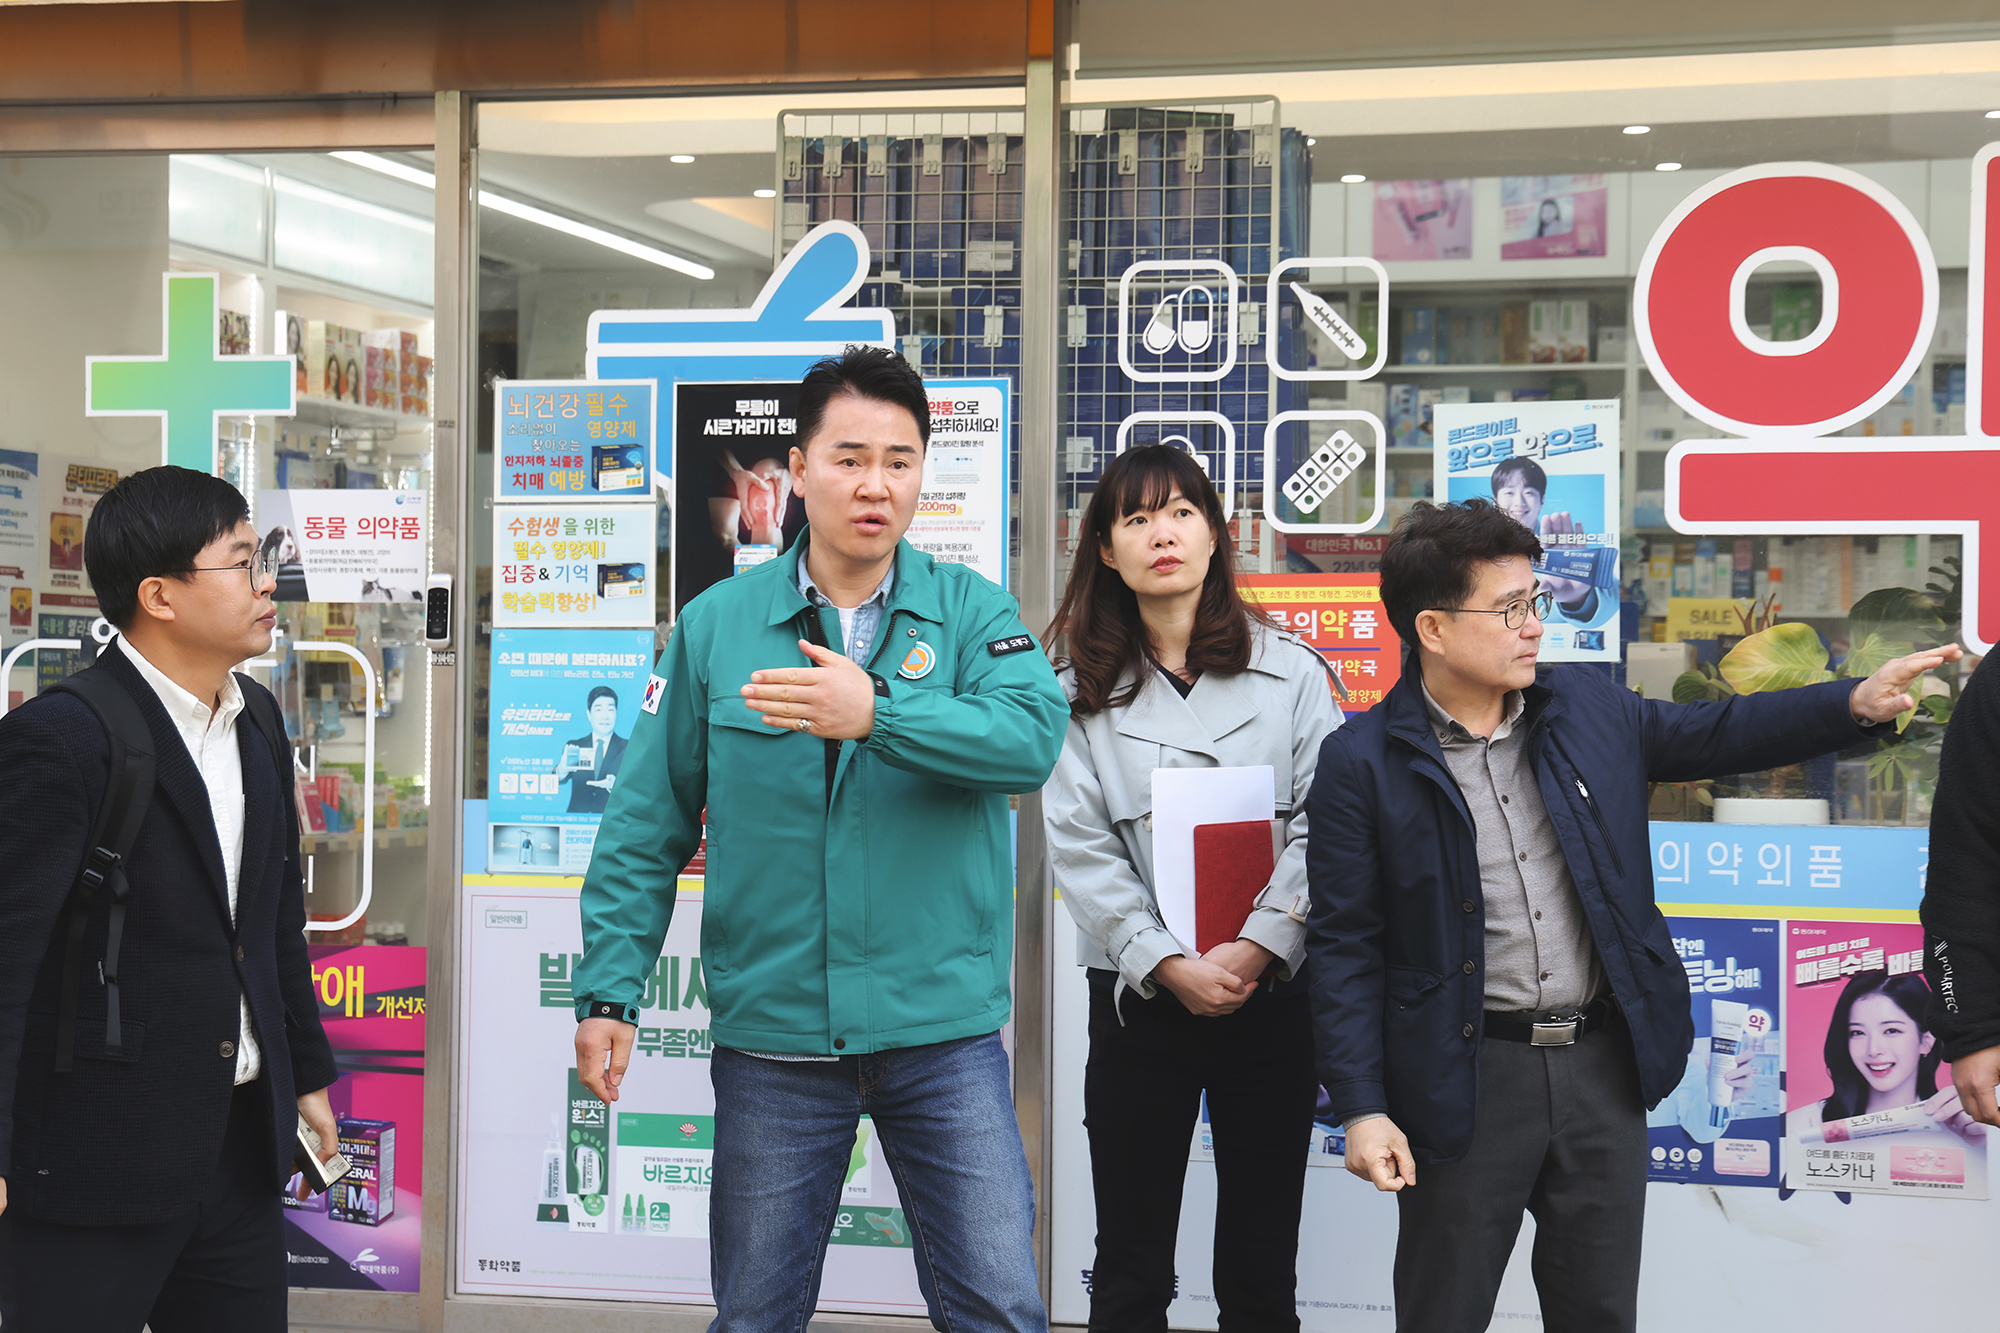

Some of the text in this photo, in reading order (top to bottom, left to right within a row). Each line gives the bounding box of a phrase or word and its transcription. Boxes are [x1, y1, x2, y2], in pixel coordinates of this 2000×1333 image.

[507, 392, 629, 419] 뇌건강 필수
[735, 399, 780, 417] 무릎이
[507, 422, 557, 436] 소리없이
[587, 420, 636, 438] 영양제
[703, 418, 775, 435] 시큰거리기
[930, 418, 999, 433] 섭취하세요!
[531, 439, 582, 453] 찾아오는
[504, 455, 585, 468] 인지저하 뇌졸중
[512, 469, 586, 491] 치매 예방
[930, 492, 945, 501] 권장
[945, 492, 967, 501] 섭취량
[304, 516, 421, 540] 동물 의약품
[583, 517, 616, 536] 위한
[513, 540, 606, 560] 필수 영양제!
[922, 543, 943, 552] 용량을
[944, 543, 973, 552] 복용해야
[1305, 538, 1382, 553] 대한민국 No.1
[554, 564, 588, 583] 기억
[1294, 590, 1317, 599] 중형견,
[1319, 590, 1342, 599] 대형견,
[1344, 590, 1373, 599] 고양이용
[1690, 609, 1733, 625] SALE
[497, 652, 525, 665] 소변
[528, 652, 568, 666] 때문에
[1347, 689, 1382, 703] 영양제
[1657, 840, 1843, 889] 의약외품
[490, 914, 523, 924] 일반의약품
[1796, 945, 1827, 960] 여드름
[1795, 948, 1884, 985] 빠를수록
[1938, 956, 1959, 1014] POLARTEC
[1748, 1014, 1766, 1032] 약
[636, 1027, 712, 1059] 무좀엔
[571, 1100, 606, 1109] 바르지오
[1806, 1149, 1875, 1161] 여드름 흉터 치료제
[347, 1168, 377, 1181] ERAL
[1806, 1161, 1876, 1182] 노스카나
[348, 1185, 377, 1216] Mg
[359, 1264, 400, 1275] 현대약품(주)
[478, 1259, 521, 1273] 동화약품
[1340, 1302, 1359, 1310] DATA)
